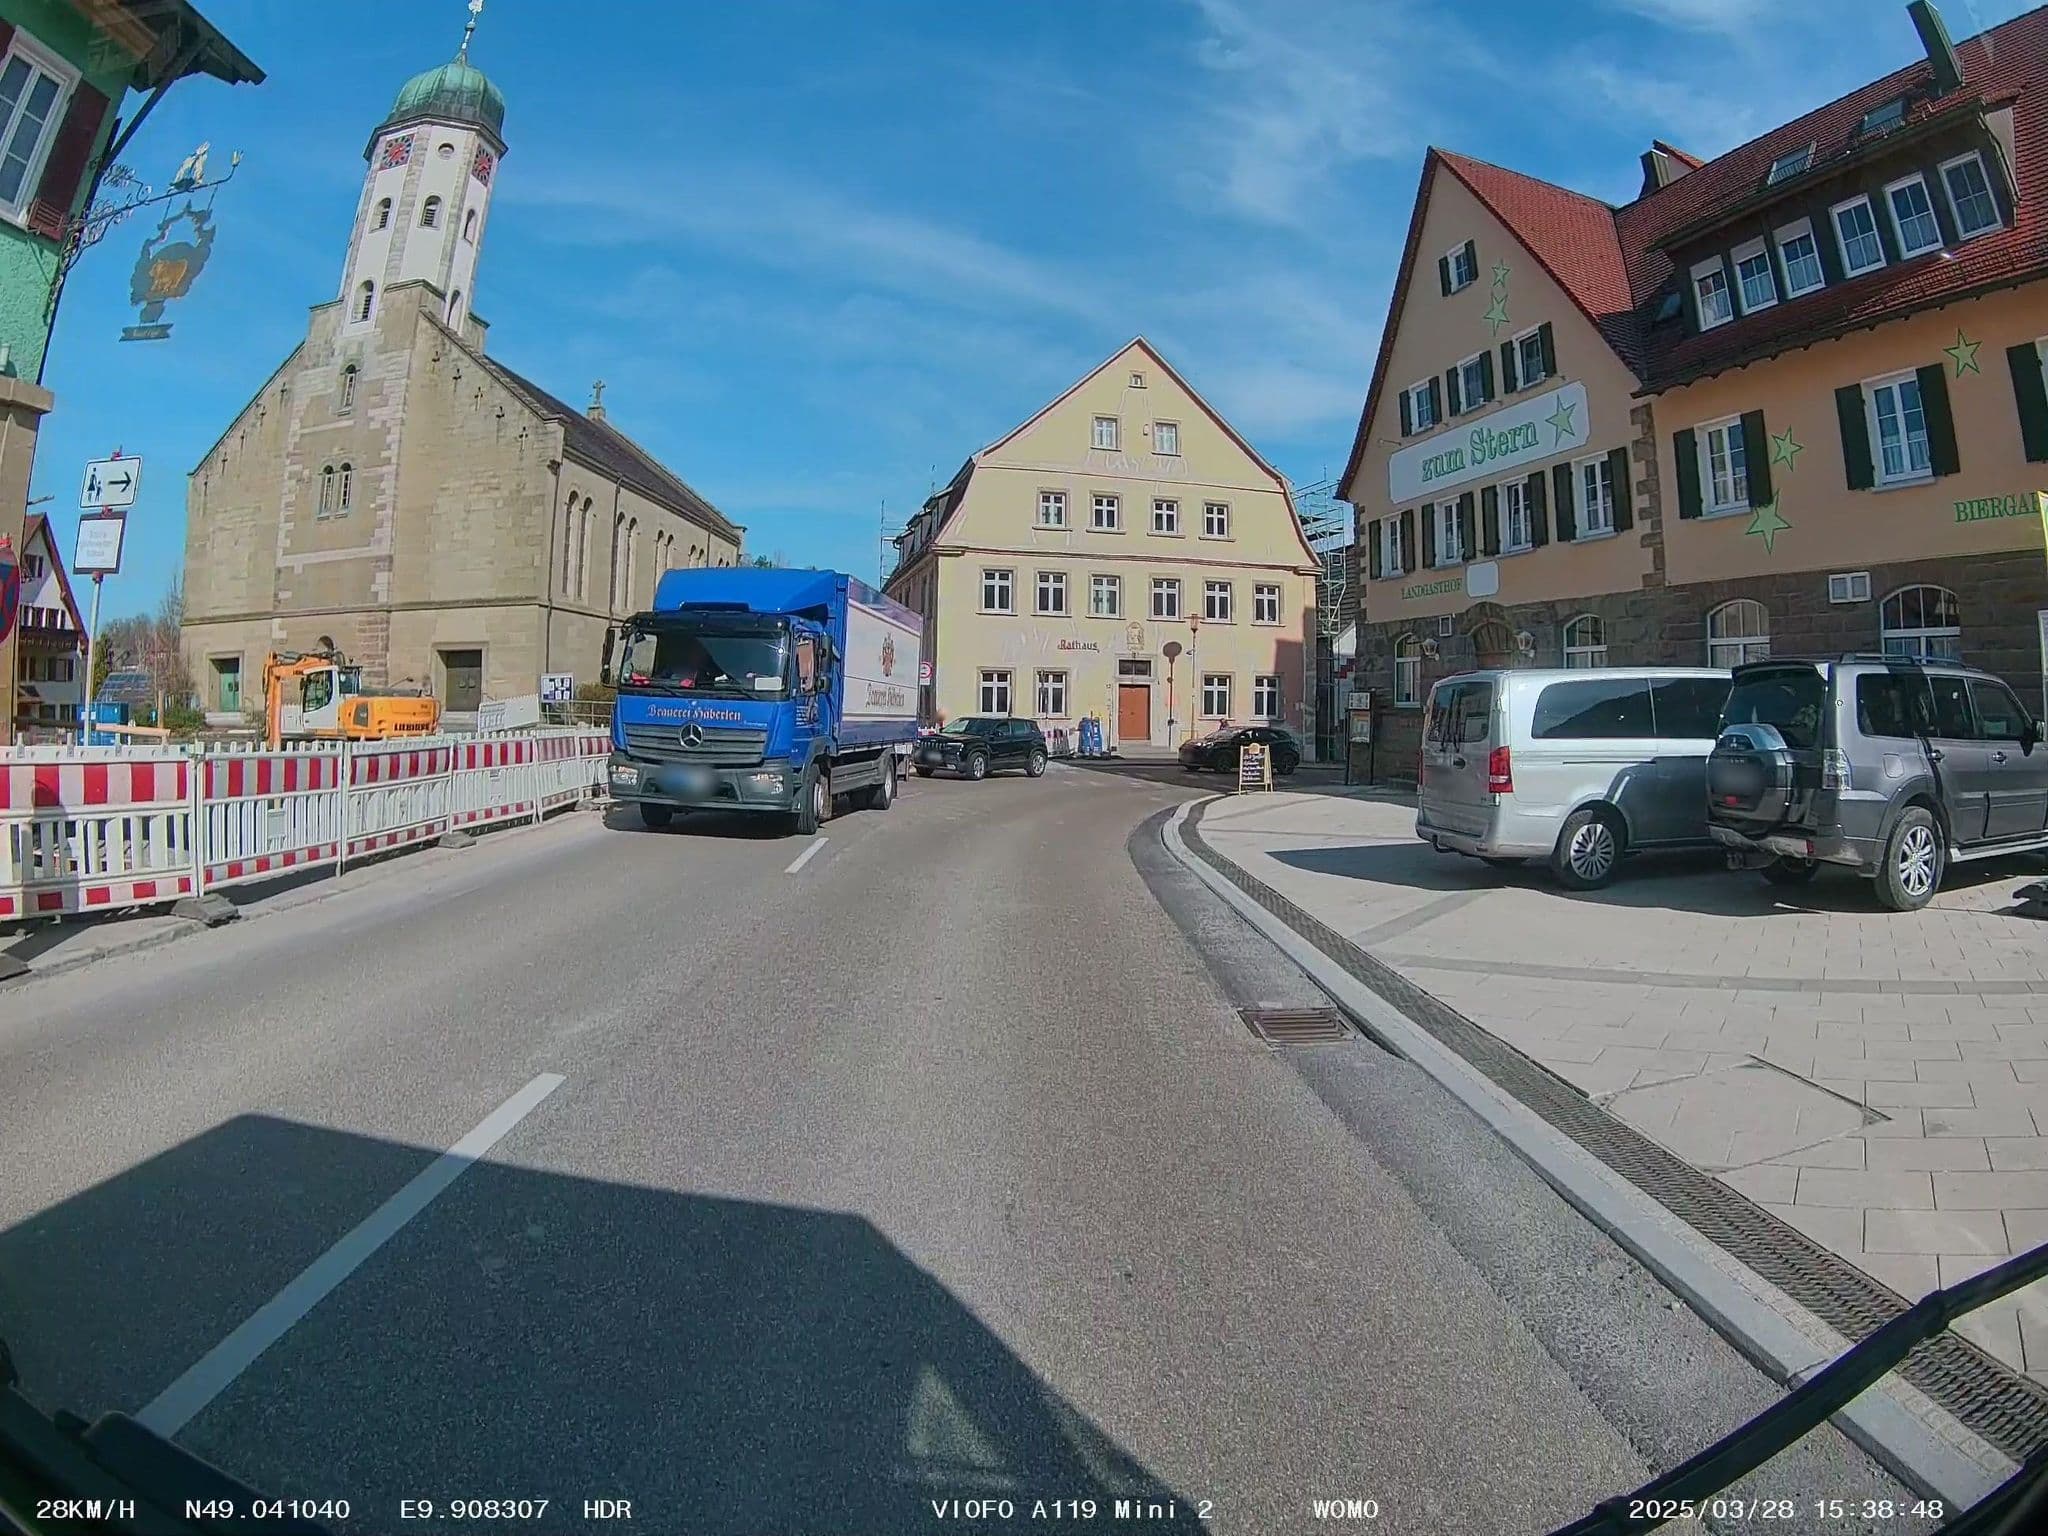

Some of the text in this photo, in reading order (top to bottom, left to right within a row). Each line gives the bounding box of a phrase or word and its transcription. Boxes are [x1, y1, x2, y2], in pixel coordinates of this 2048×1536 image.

[1421, 422, 1539, 482] zum Stern
[1401, 577, 1463, 600] LANDGASTHOF
[1058, 639, 1100, 653] Rathaus
